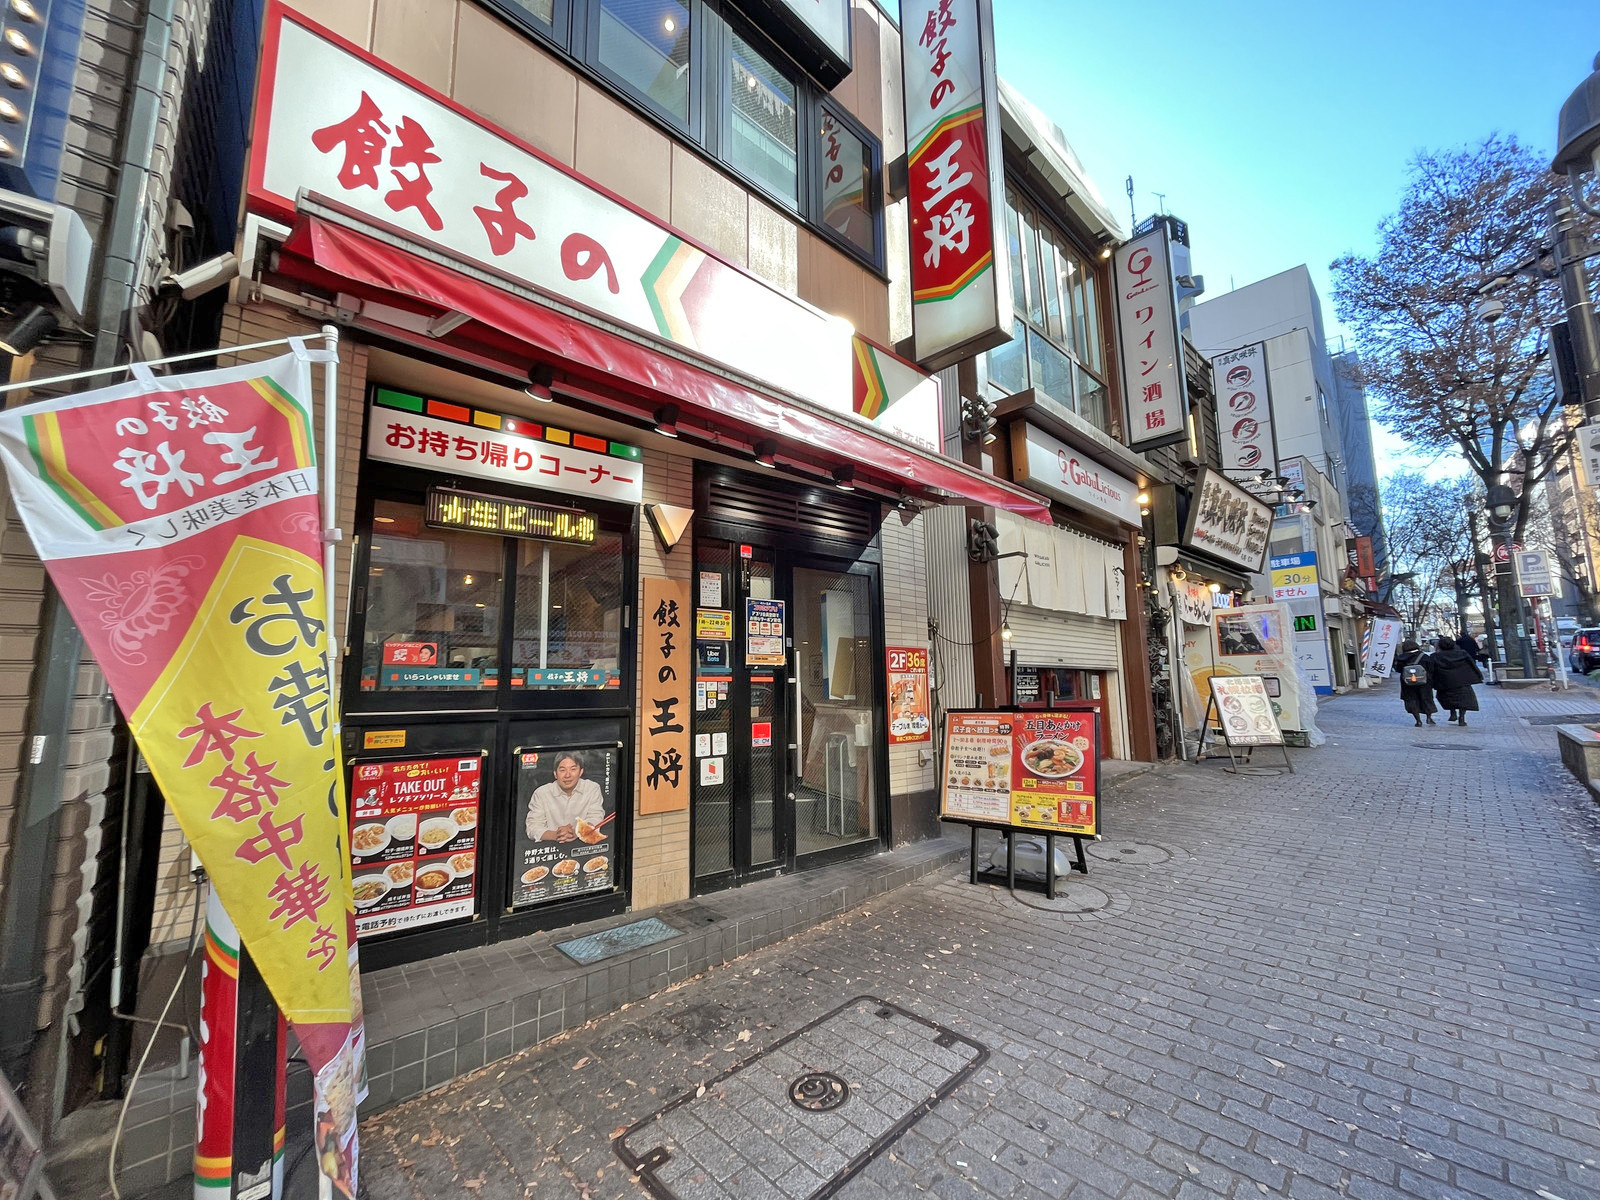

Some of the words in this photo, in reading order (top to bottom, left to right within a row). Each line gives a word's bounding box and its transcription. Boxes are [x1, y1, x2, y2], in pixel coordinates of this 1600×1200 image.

[311, 90, 620, 295] 餃子の
[922, 140, 975, 269] 王将
[1136, 305, 1166, 431] ワイン酒場
[385, 422, 634, 484] お持ち帰りコーナー
[1070, 458, 1121, 501] GabuLicious
[1271, 557, 1300, 568] 駐車場
[1522, 554, 1541, 572] P
[1275, 588, 1307, 598] ません
[1535, 584, 1550, 593] IN
[1295, 616, 1315, 630] IN
[890, 653, 906, 668] 2F
[403, 673, 460, 681] いらっしゃいませ
[547, 671, 589, 683] 餃子の王将
[647, 598, 684, 791] 餃子の王将
[953, 726, 999, 734] 餃子食べ放題つき
[1024, 719, 1081, 731] 五目あんかけ
[1035, 730, 1069, 741] ラーメン
[394, 780, 421, 794] TAKE
[424, 778, 446, 792] OUT
[390, 792, 449, 803] レンチンシリーズ
